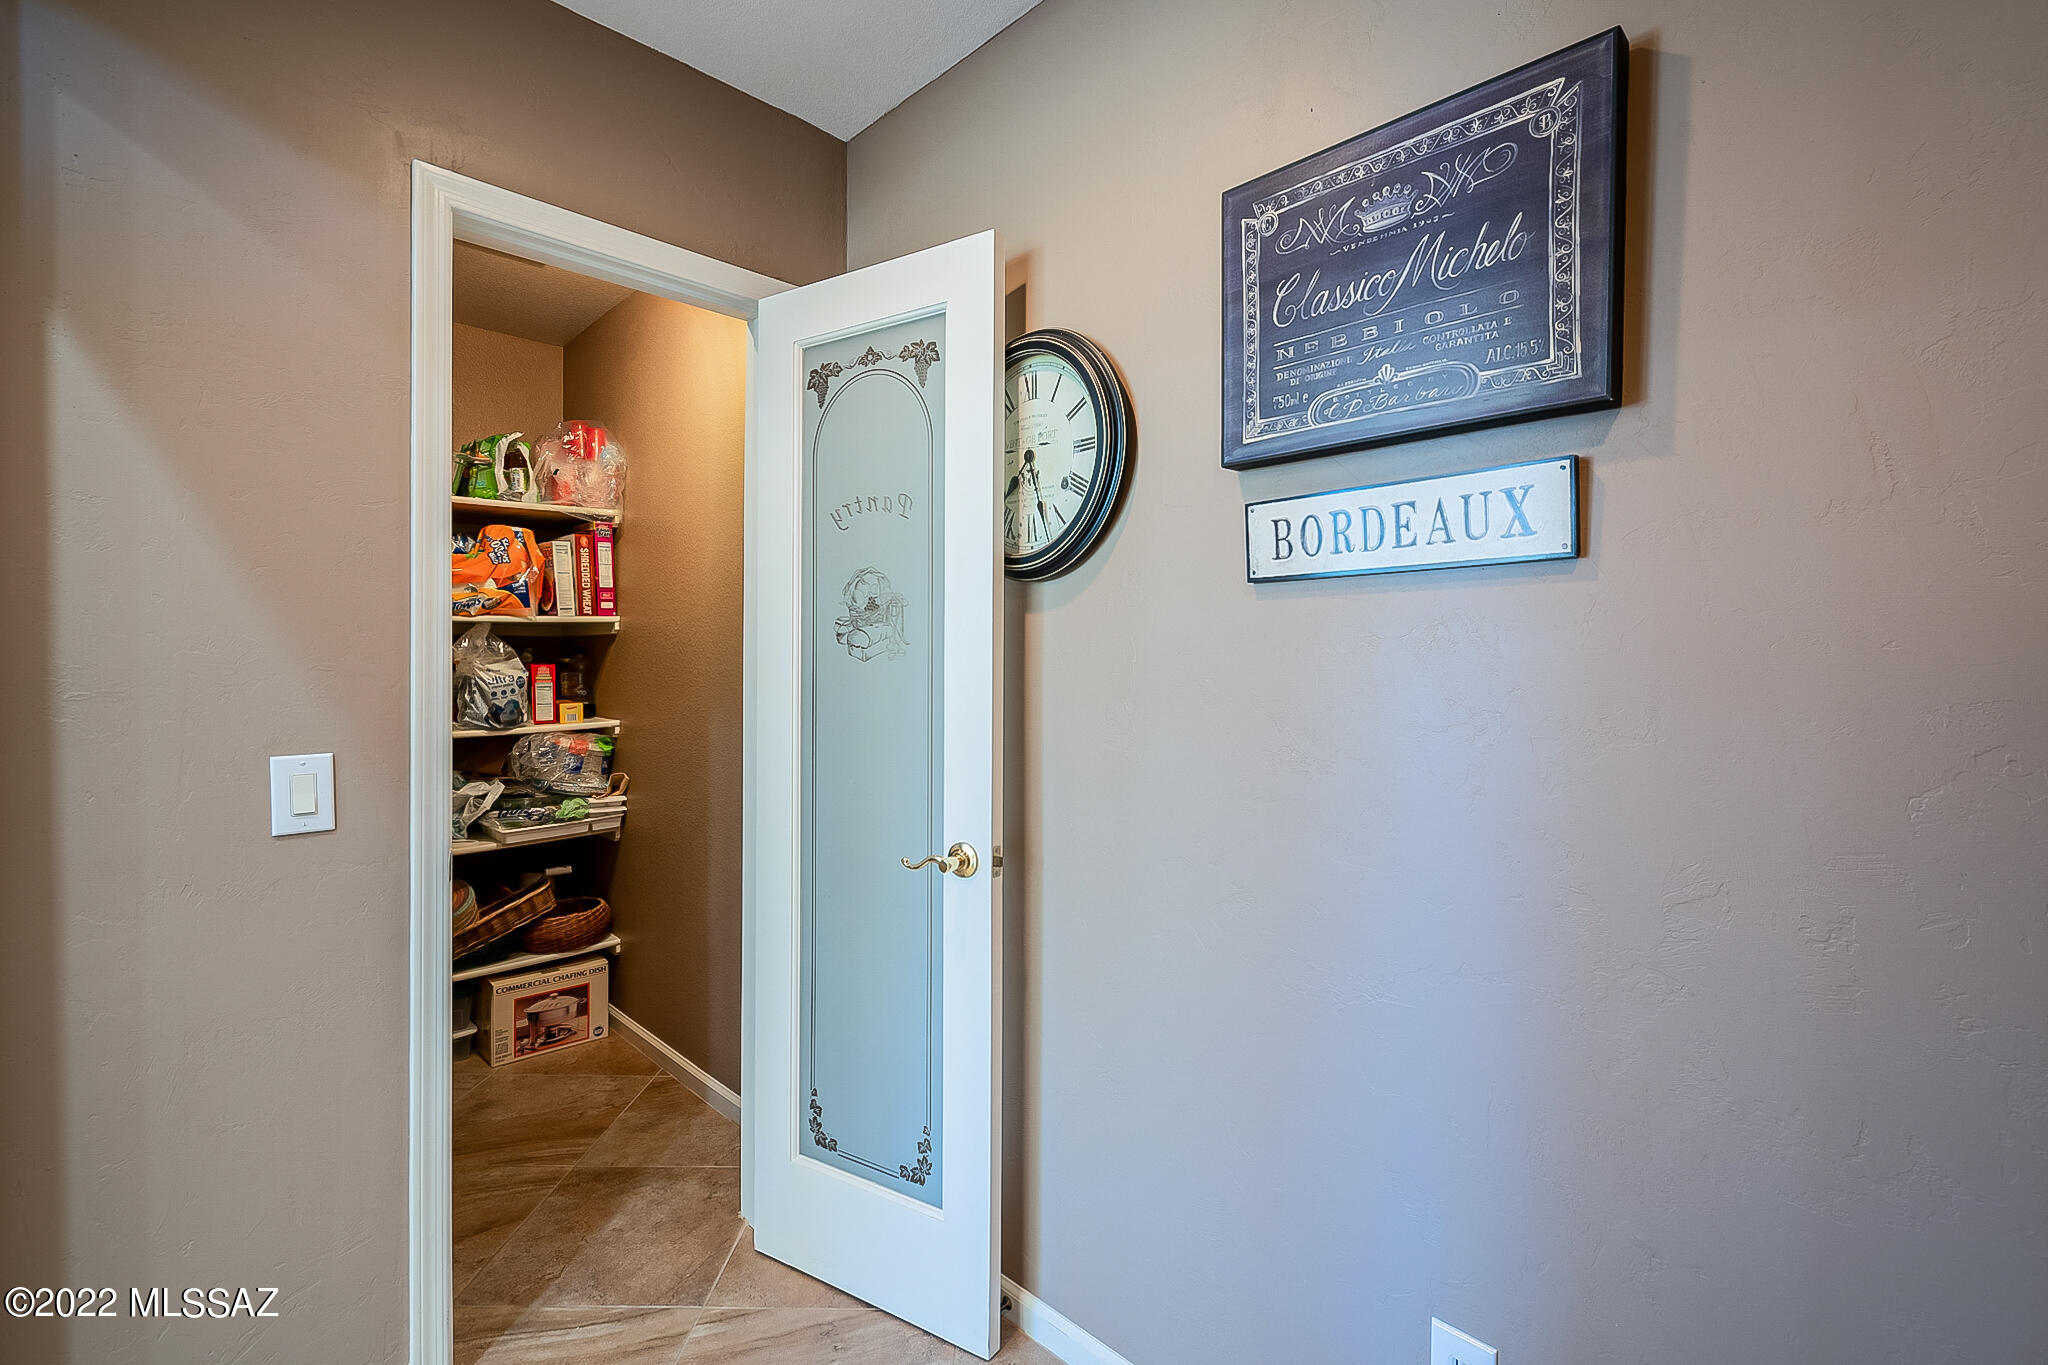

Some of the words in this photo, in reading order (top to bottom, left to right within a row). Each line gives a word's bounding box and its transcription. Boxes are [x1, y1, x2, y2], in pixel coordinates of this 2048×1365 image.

[1272, 268, 1397, 328] Classico
[1275, 289, 1520, 362] NEBBIOLO
[1422, 320, 1498, 345] CONTROLLATA
[1503, 316, 1513, 327] E
[1435, 330, 1500, 352] GARANTITA
[1276, 356, 1353, 381] DENOMINAZIONE
[1290, 376, 1300, 386] DI
[1271, 484, 1538, 561] BORDEAUX
[579, 547, 591, 588] SHREDDED
[582, 590, 592, 615] WHEAT
[496, 978, 551, 995] COMMERCIAL
[553, 970, 588, 983] CHAFING
[588, 965, 607, 975] DISH
